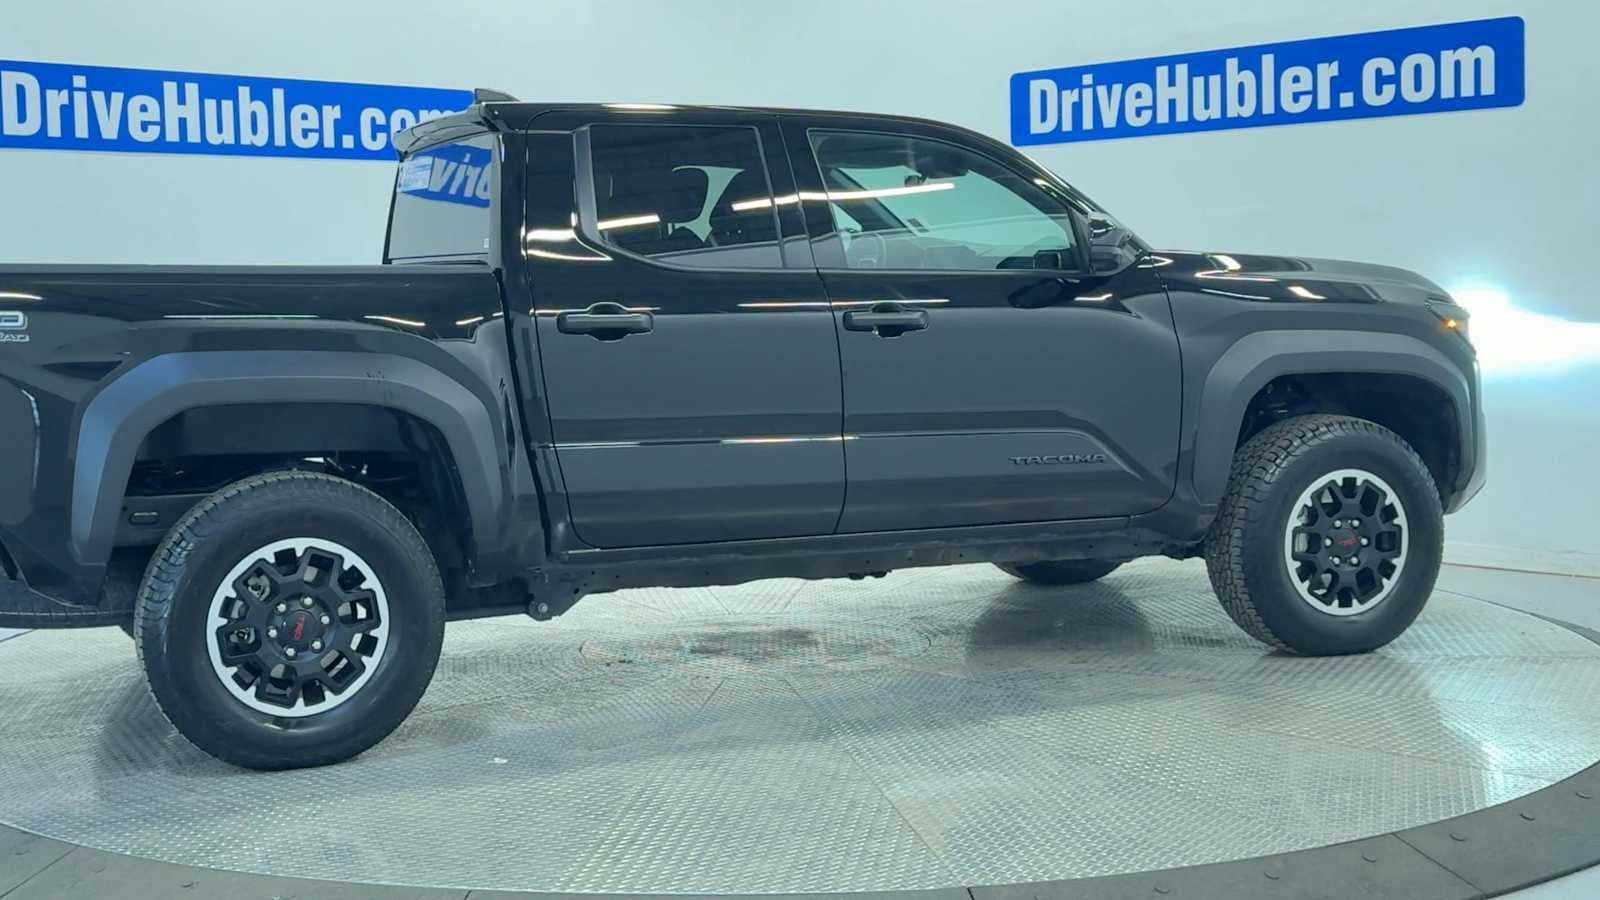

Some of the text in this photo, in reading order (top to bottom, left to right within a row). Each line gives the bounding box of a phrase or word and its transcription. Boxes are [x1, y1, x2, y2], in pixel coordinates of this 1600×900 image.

[1, 71, 460, 151] DriveHubler.co
[1028, 43, 1496, 136] DriveHubler.com
[1008, 455, 1105, 465] TACOMA
